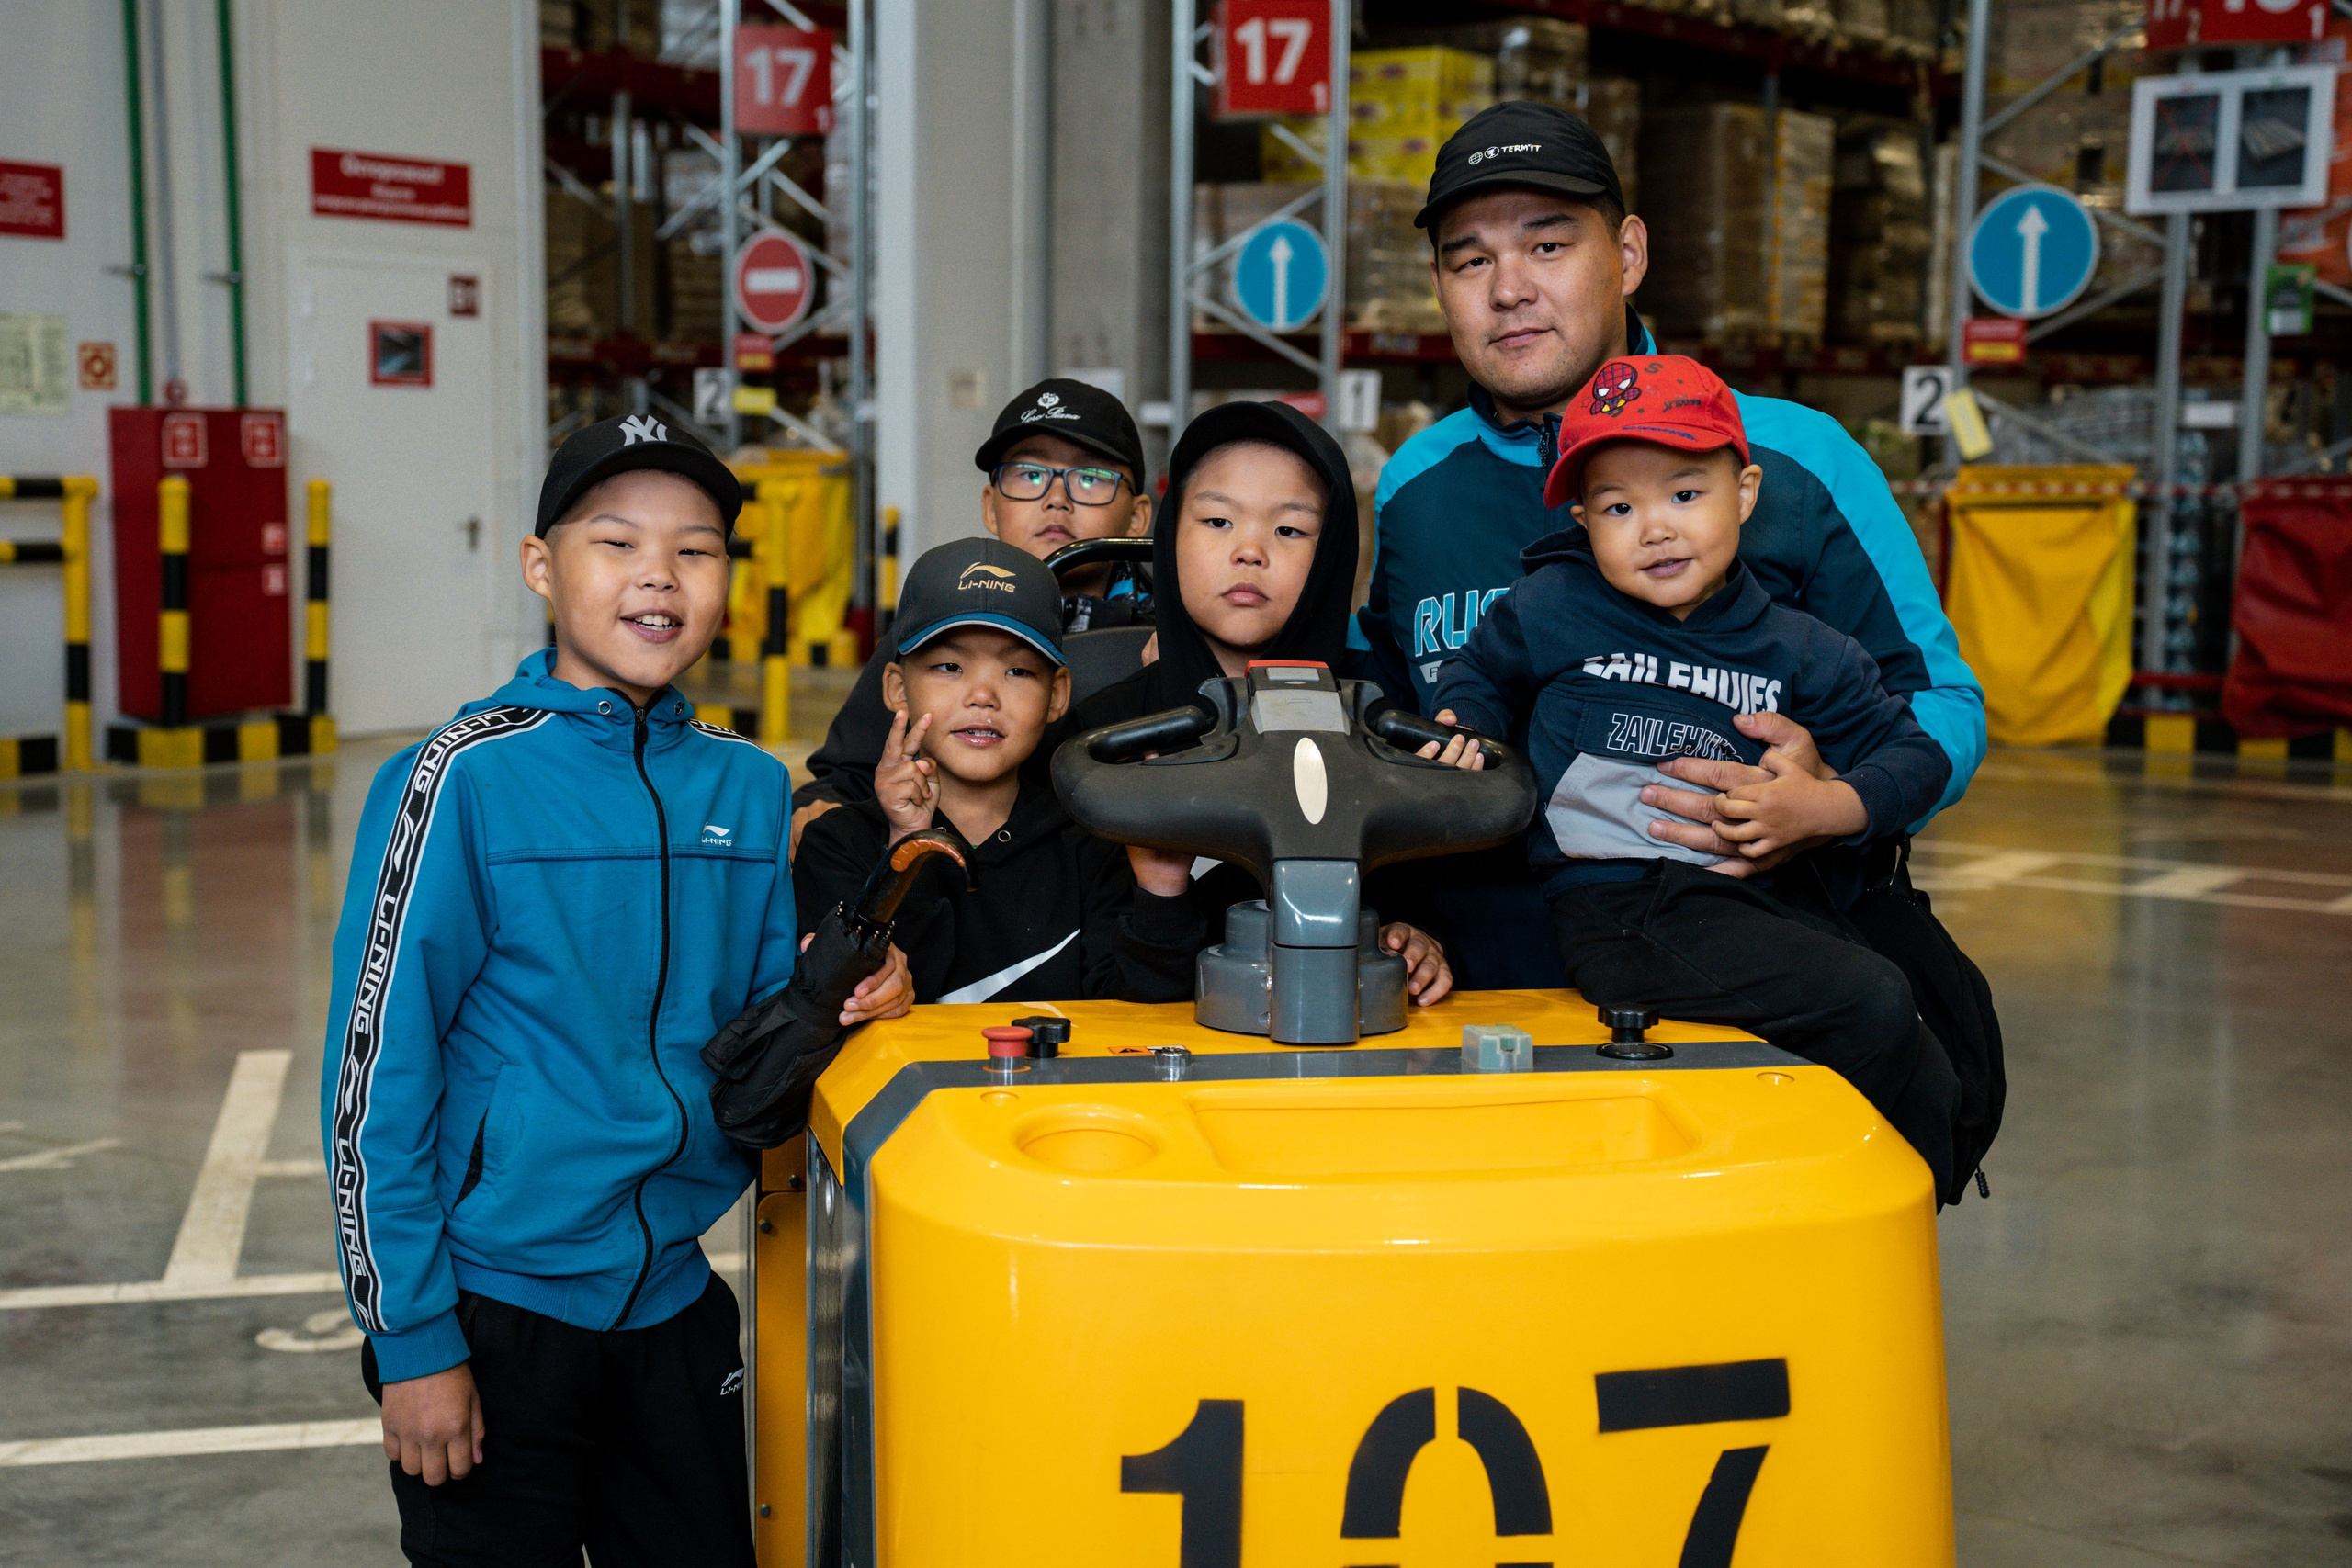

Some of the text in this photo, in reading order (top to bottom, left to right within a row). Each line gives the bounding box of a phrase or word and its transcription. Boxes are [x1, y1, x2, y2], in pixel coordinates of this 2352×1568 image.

[1233, 16, 1313, 85] 17
[2309, 4, 2325, 40] 1
[743, 45, 818, 107] 17
[1310, 81, 1328, 112] 1
[1913, 374, 1944, 426] 2
[618, 414, 667, 446] NY
[957, 579, 1016, 592] LI-NING
[414, 713, 510, 794] LI-NING
[701, 836, 732, 847] LI-NING
[356, 893, 396, 1035] LI-NING
[338, 1137, 367, 1277] LI-NING
[1120, 1357, 1791, 1568] 107
